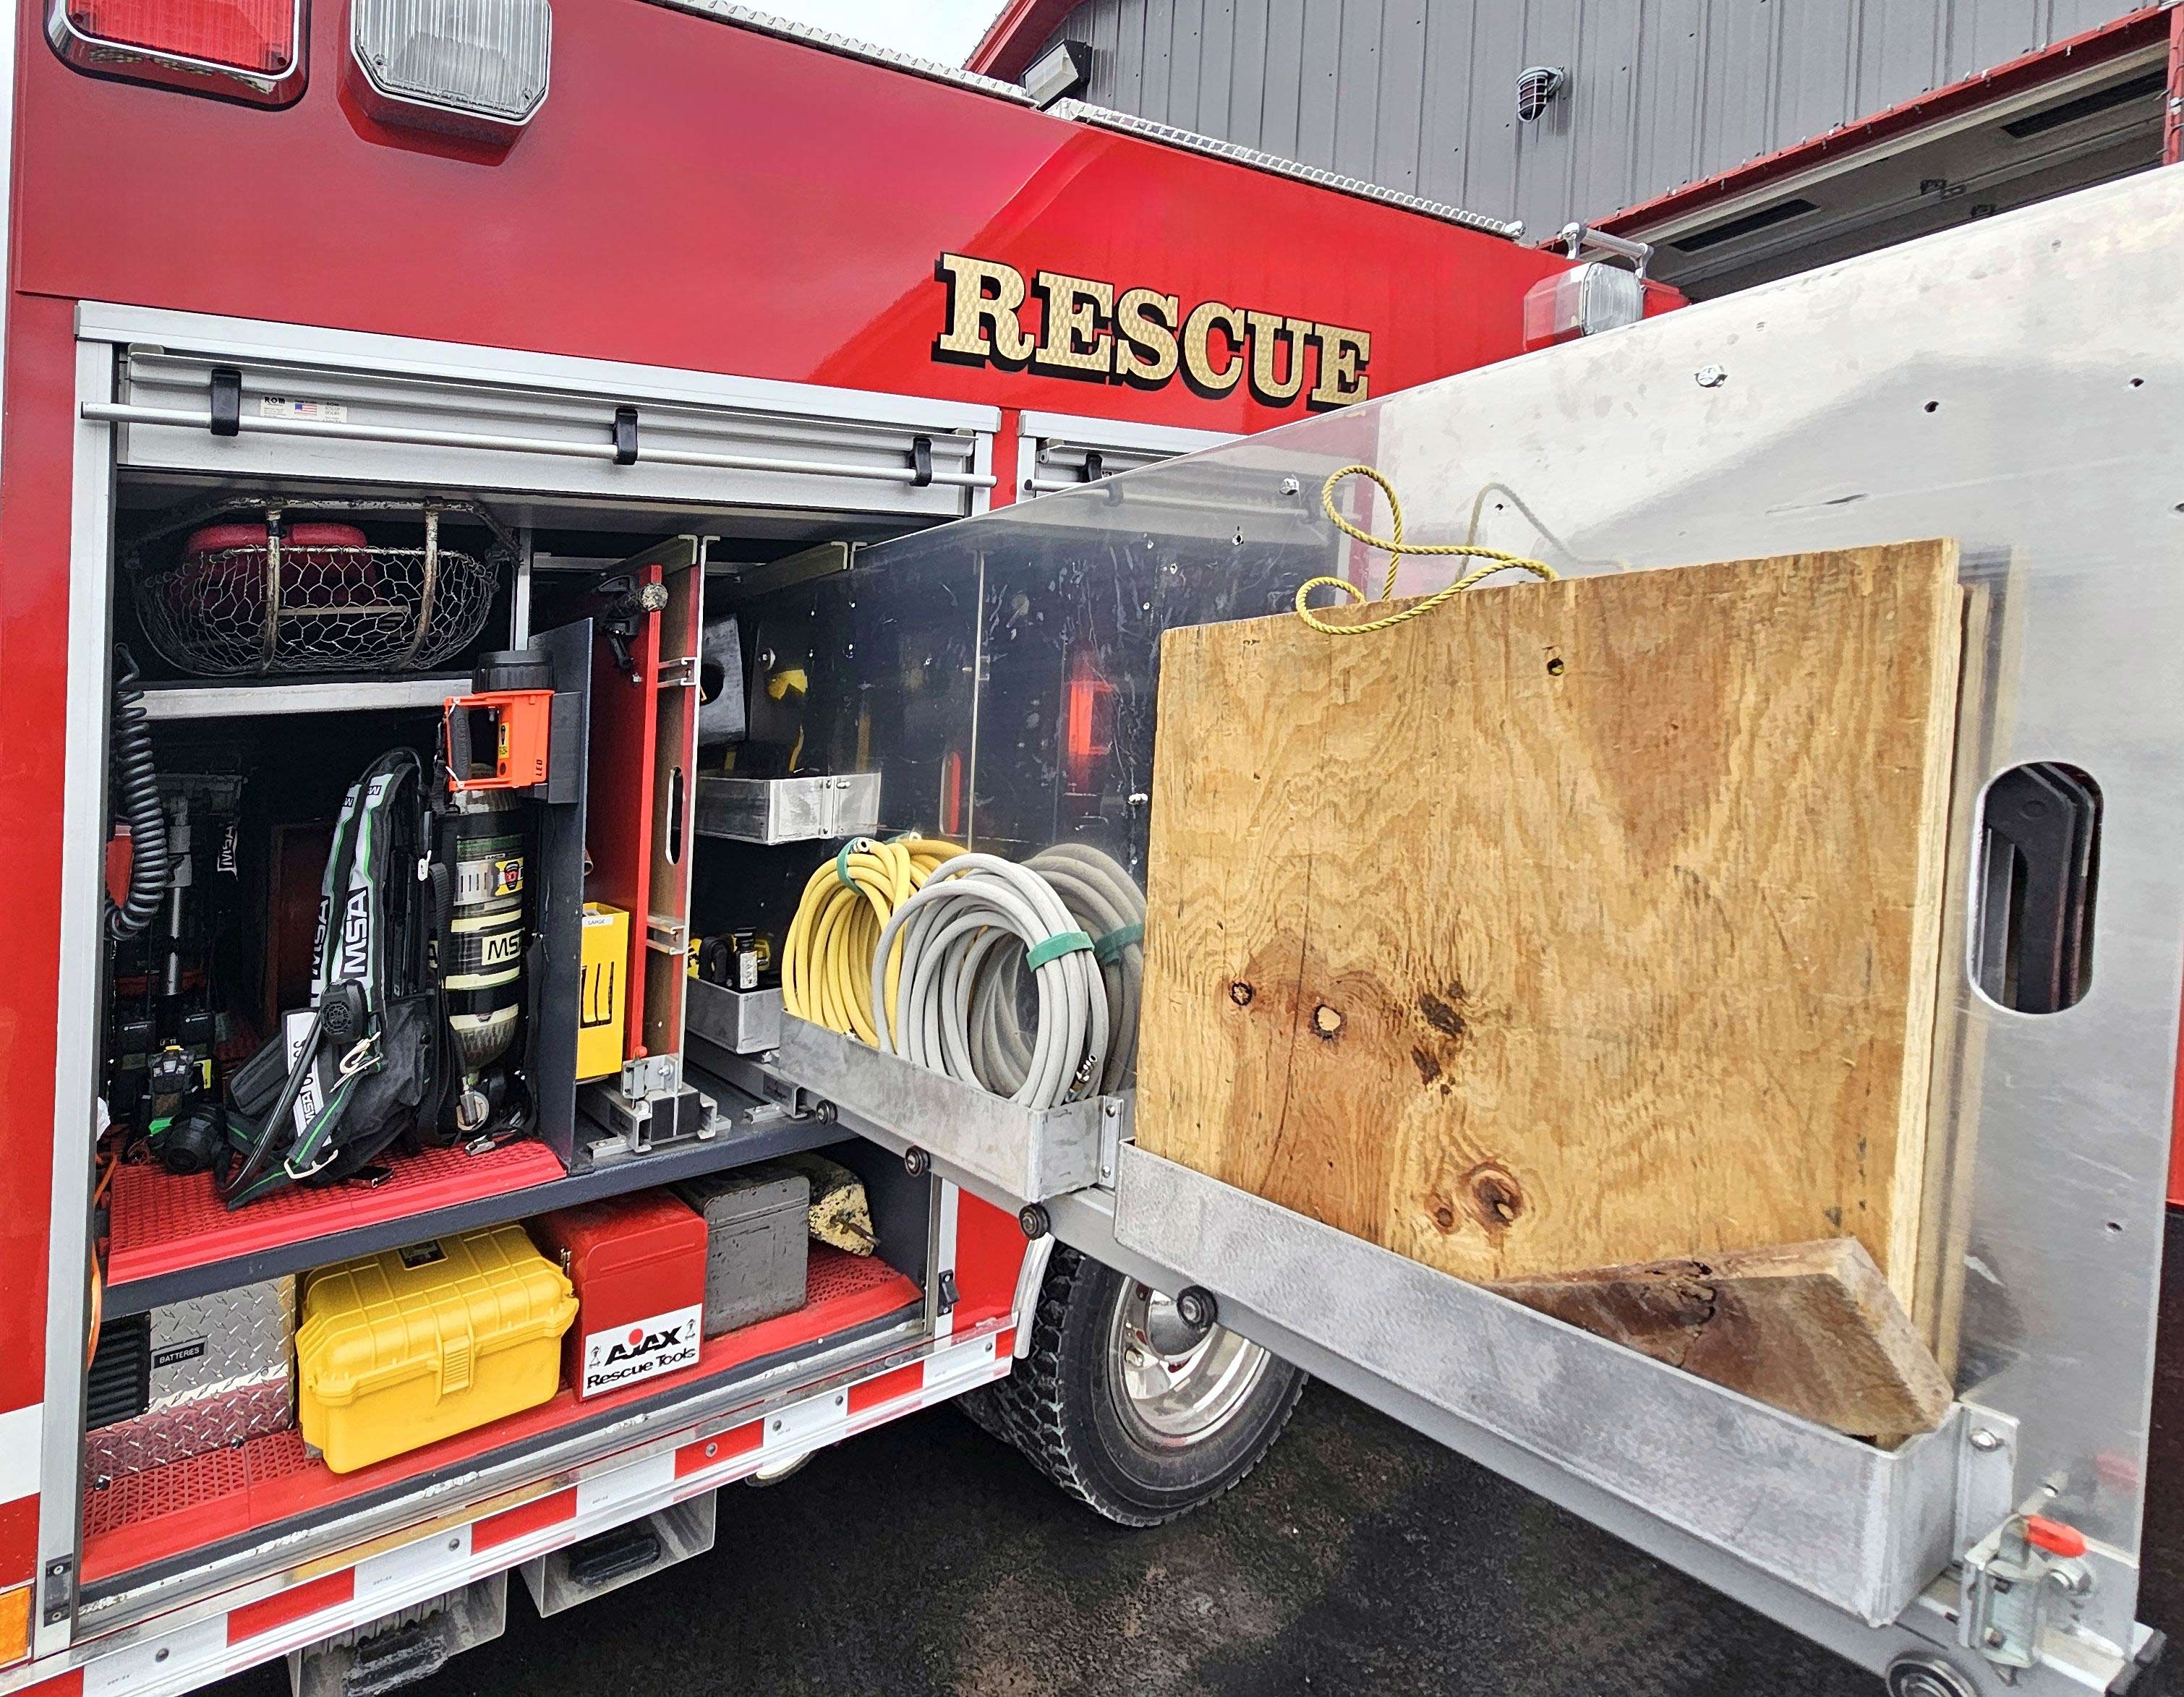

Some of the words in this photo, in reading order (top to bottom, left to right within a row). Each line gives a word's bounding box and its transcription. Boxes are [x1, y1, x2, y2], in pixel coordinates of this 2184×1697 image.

[931, 252, 1370, 412] RESCUE
[221, 826, 233, 865] MSA
[344, 889, 367, 973] MSA
[487, 933, 521, 961] MS
[159, 1346, 200, 1364] BATTERIES
[604, 1325, 682, 1367] AJAX
[587, 1362, 654, 1389] Rescue
[655, 1348, 696, 1368] Tools
